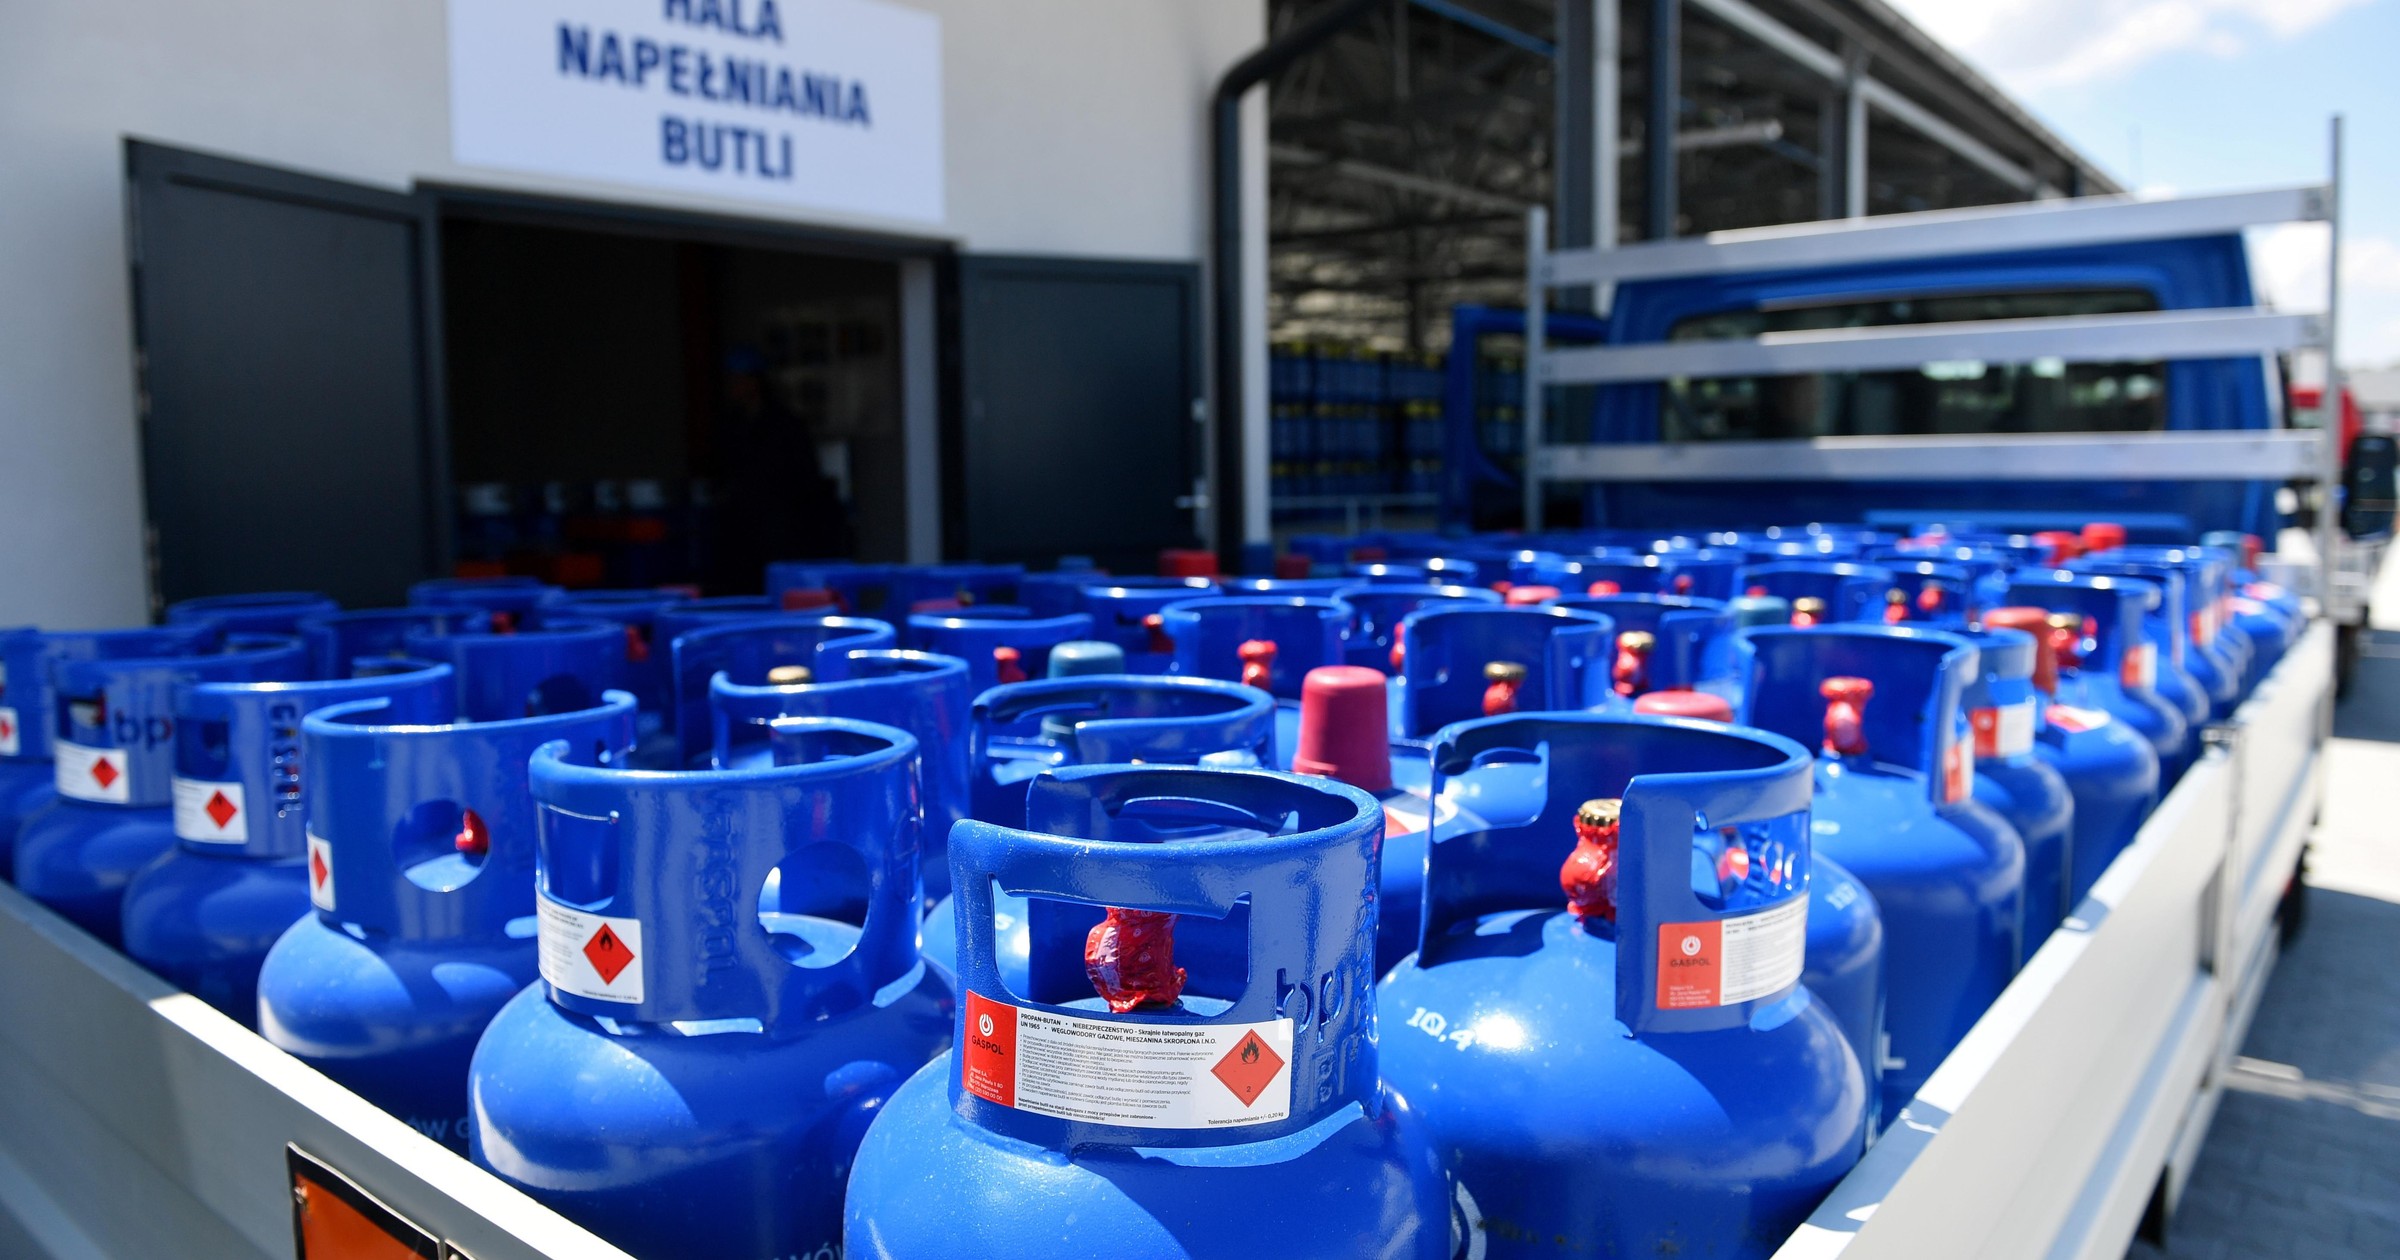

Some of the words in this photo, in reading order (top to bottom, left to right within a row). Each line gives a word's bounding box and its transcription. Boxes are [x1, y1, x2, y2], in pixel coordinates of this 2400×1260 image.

[556, 22, 871, 130] NAPEŁNIANIA
[659, 114, 794, 182] BUTLI
[1670, 958, 1711, 968] GASPOL
[1021, 1012, 1061, 1026] PROPAN-BUTAN
[1072, 1022, 1134, 1035] NIEBEZPIECZEŃSTWO
[1029, 1022, 1040, 1030] 1965
[1051, 1026, 1096, 1039] WĘGLOWODORY
[1097, 1033, 1125, 1043] GAZOWE,
[971, 1035, 1004, 1056] GASPOL
